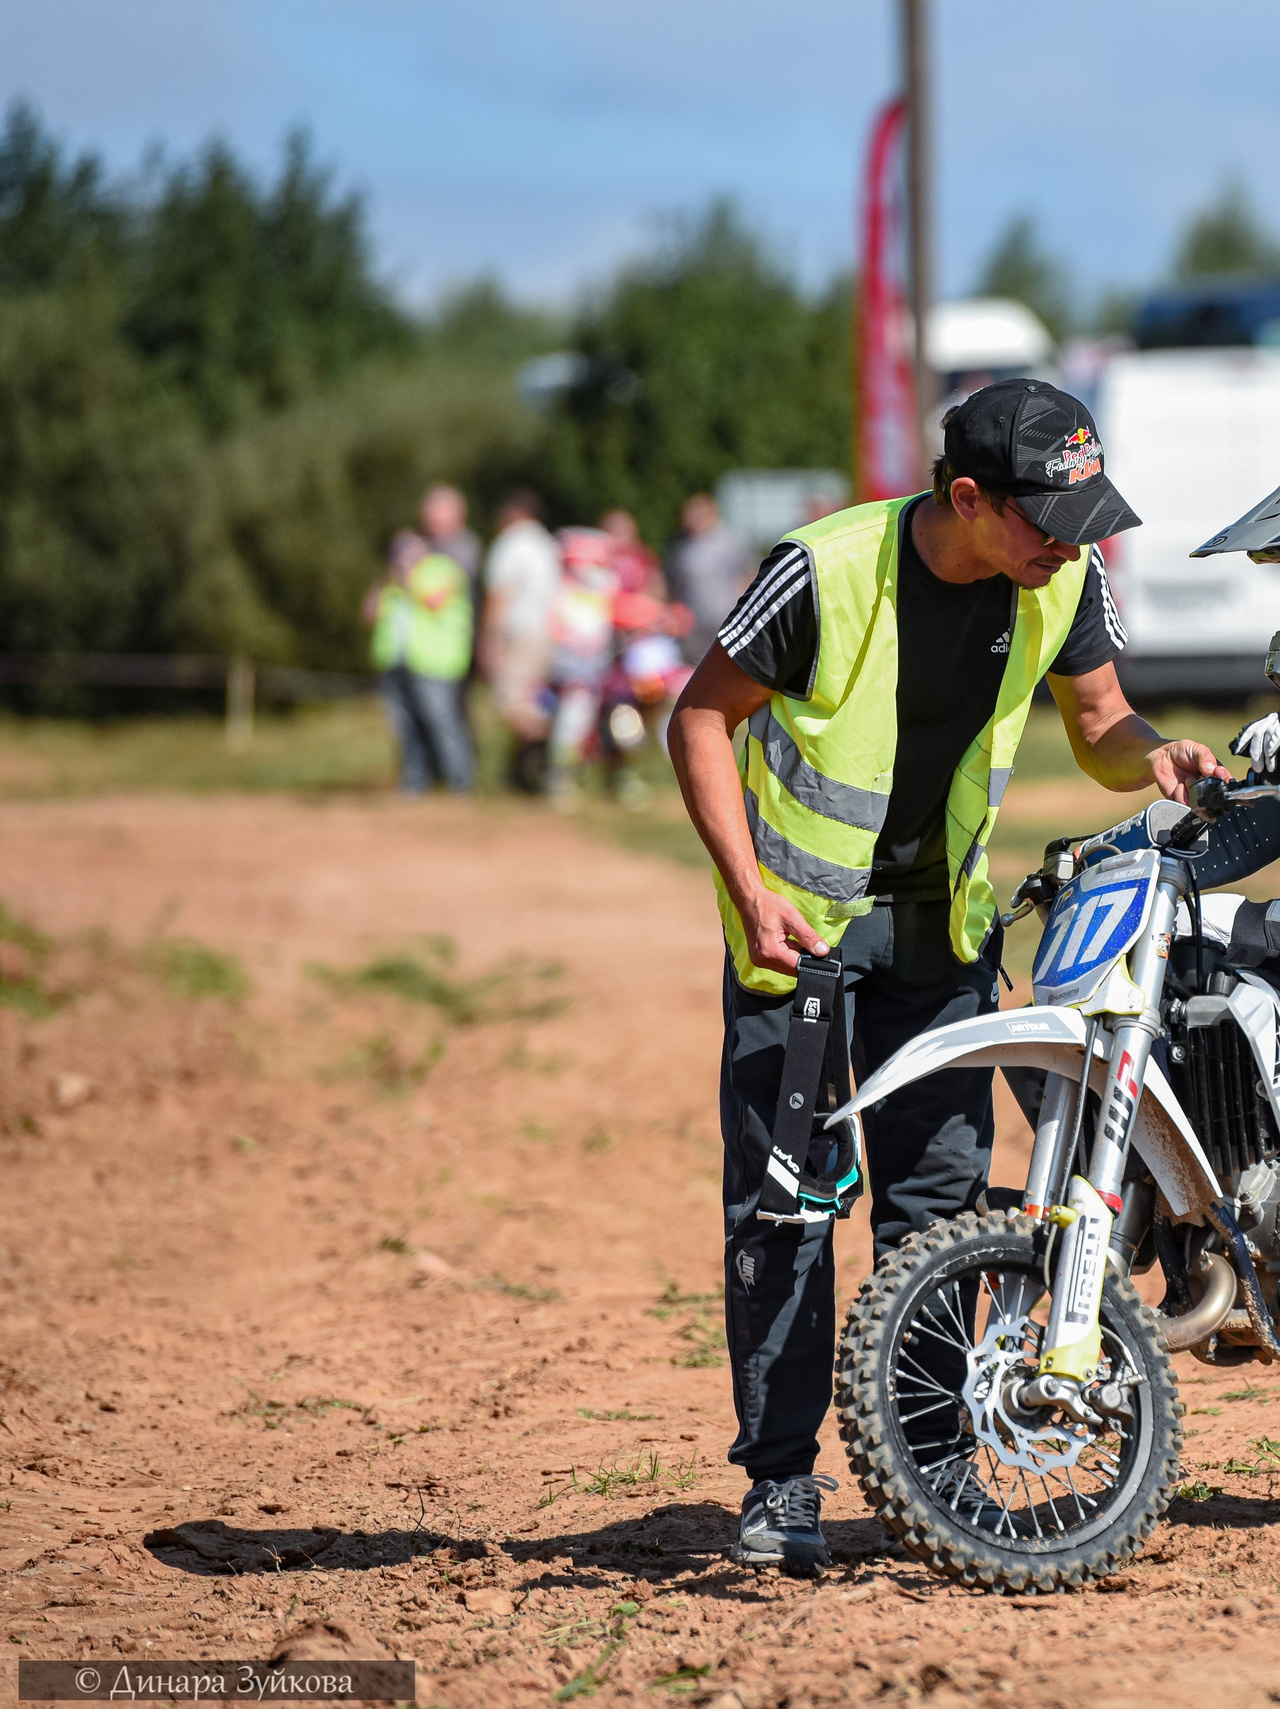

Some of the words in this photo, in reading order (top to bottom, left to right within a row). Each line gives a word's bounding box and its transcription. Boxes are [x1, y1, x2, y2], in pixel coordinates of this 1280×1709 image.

[1069, 457, 1102, 484] KTM
[990, 643, 1009, 653] adi
[742, 1254, 756, 1286] NIKE
[1065, 1214, 1101, 1326] PIRELLI
